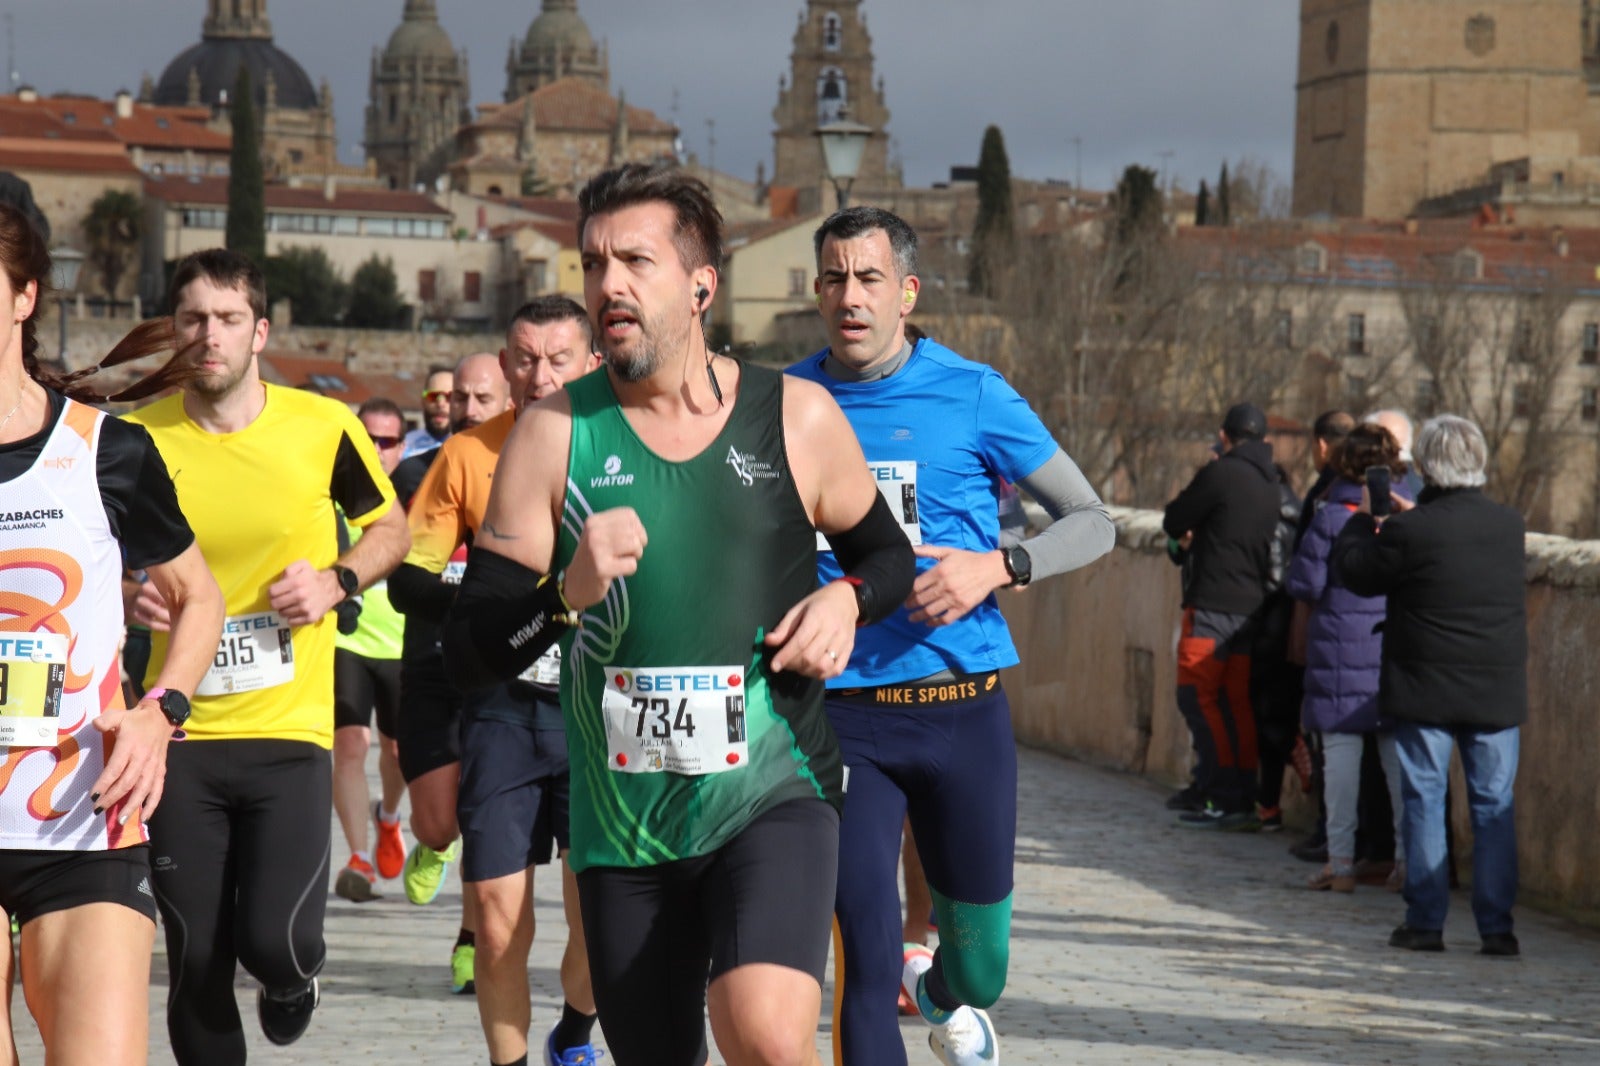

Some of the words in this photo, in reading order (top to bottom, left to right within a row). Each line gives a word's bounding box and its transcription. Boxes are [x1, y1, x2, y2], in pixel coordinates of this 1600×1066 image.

[591, 474, 634, 488] VIATOR
[222, 615, 279, 633] ETEL
[214, 635, 254, 668] 615
[635, 674, 728, 692] SETEL
[876, 688, 913, 703] NIKE
[918, 681, 977, 703] SPORTS
[631, 696, 695, 738] 734
